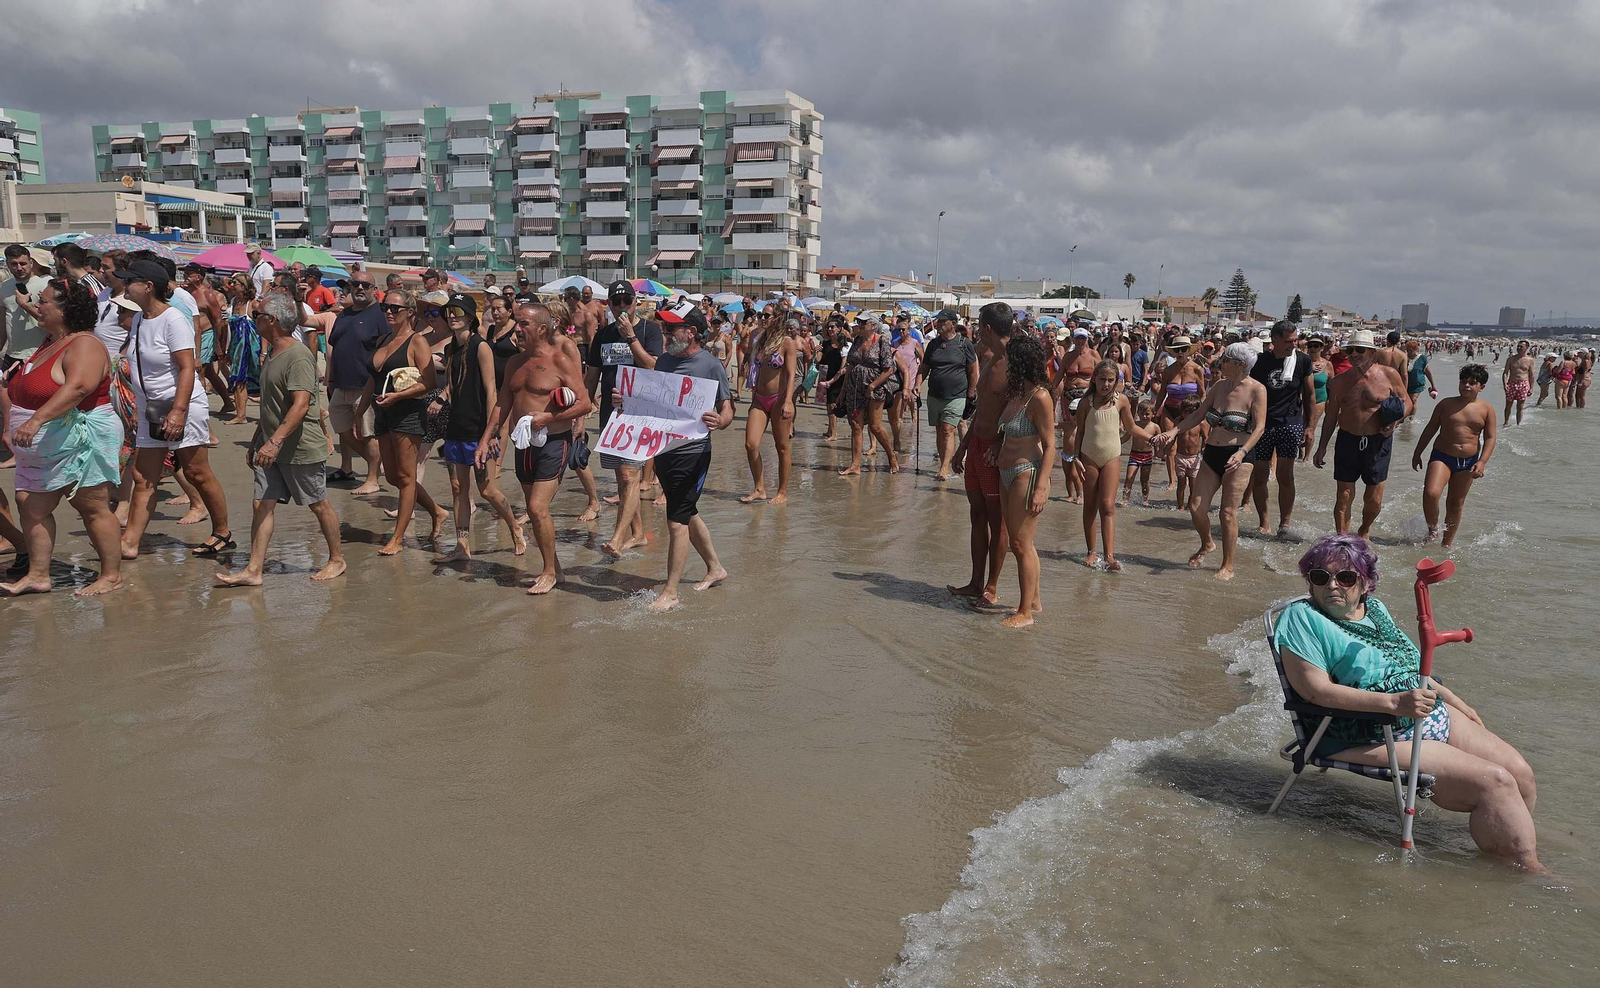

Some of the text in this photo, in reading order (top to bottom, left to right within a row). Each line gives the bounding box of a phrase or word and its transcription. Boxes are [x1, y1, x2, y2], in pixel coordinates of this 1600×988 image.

[620, 367, 705, 418] Nuestra Playa
[601, 421, 635, 451] LOS
